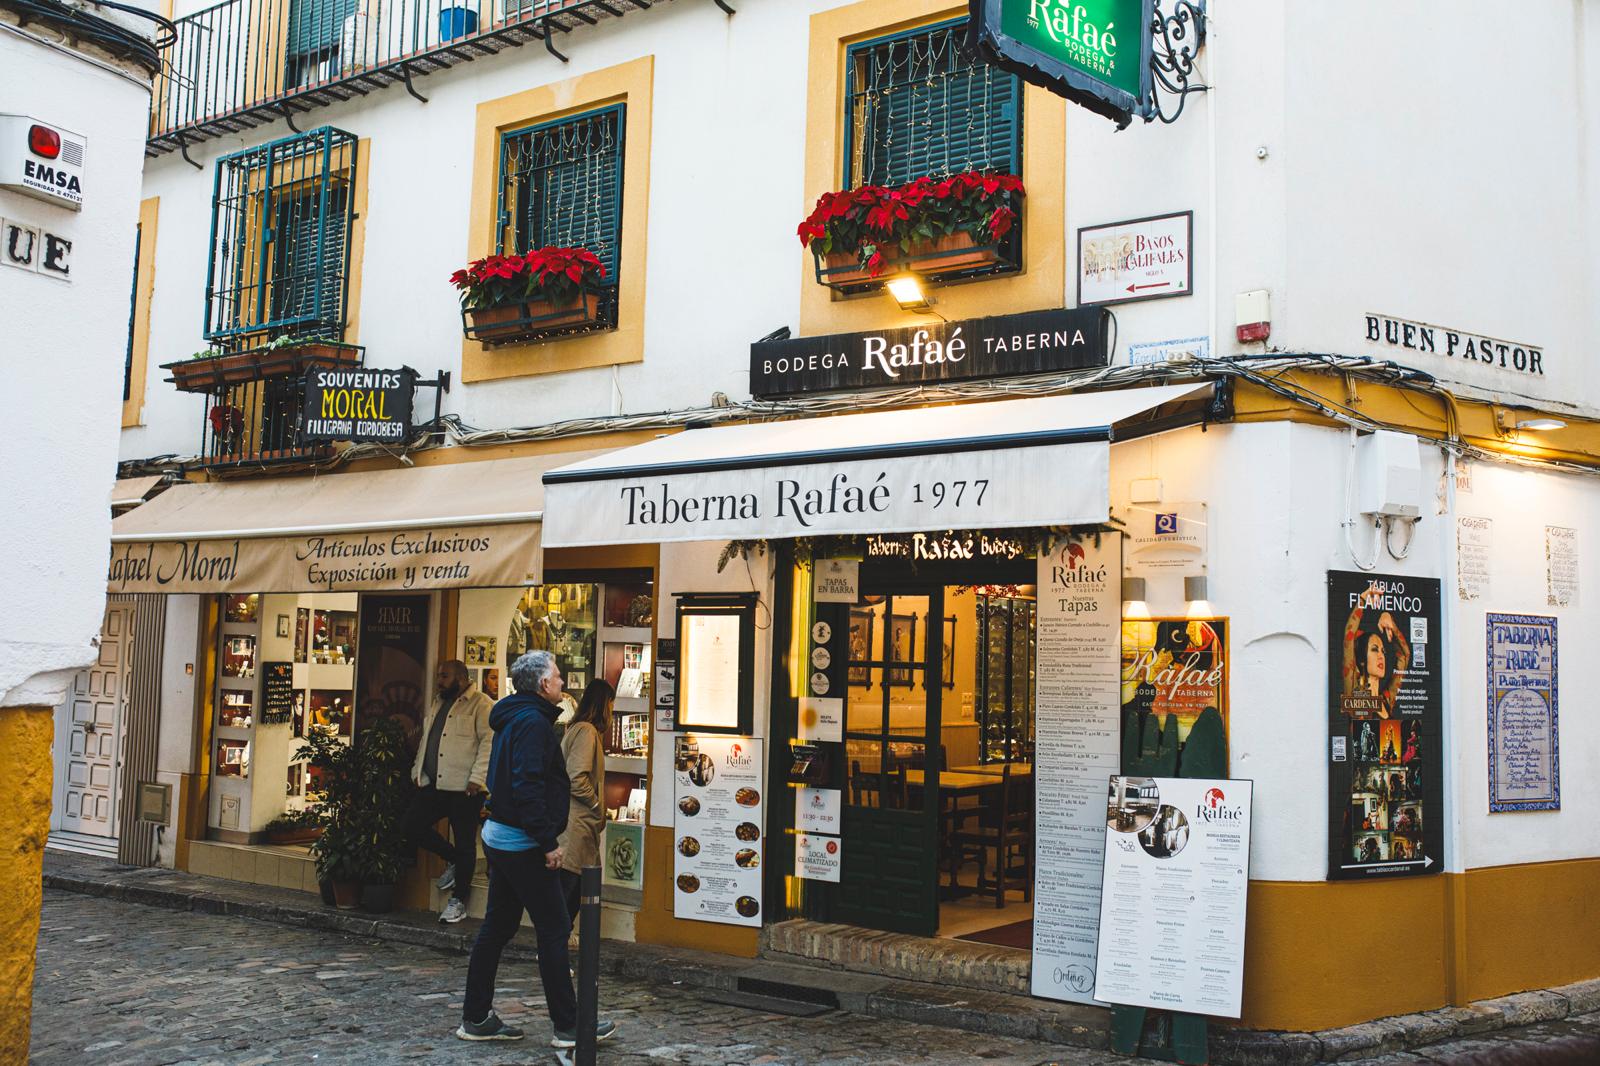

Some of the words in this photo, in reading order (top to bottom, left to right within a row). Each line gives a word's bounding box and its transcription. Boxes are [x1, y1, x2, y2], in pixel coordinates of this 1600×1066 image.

[1064, 38, 1105, 64] BODEGA
[1110, 60, 1116, 70] &
[1068, 50, 1112, 77] TABERNA
[24, 160, 81, 194] EMSA
[24, 178, 54, 192] SEGURIDAD
[763, 353, 849, 374] BODEGA
[862, 327, 966, 378] Rafaé
[984, 330, 1086, 354] TABERNA
[1366, 316, 1434, 352] BUEN
[1446, 332, 1544, 374] PASTOR
[318, 372, 400, 388] SOUVENIRS
[321, 389, 392, 420] MORAL
[307, 420, 352, 434] FILIGRANA
[356, 422, 403, 437] CORDOBESA
[621, 484, 762, 526] Taberna
[774, 472, 890, 527] Rafaé
[912, 480, 990, 508] 1977
[296, 536, 386, 560] Artículos
[391, 532, 490, 556] Exclusivos
[156, 540, 240, 584] Moral
[308, 563, 398, 590] Exposición
[403, 565, 416, 588] y
[422, 561, 470, 579] venta
[1052, 564, 1106, 588] Rafaé
[1368, 580, 1404, 594] TABLAO
[1058, 599, 1098, 615] Tapas
[1349, 593, 1422, 612] FLAMENCO
[1493, 626, 1552, 647] TABERNA
[1344, 698, 1380, 709] CARDENAL
[726, 755, 752, 767] Rafaé
[1197, 805, 1242, 822] Rafaé
[798, 857, 838, 867] CLIMATIZADO
